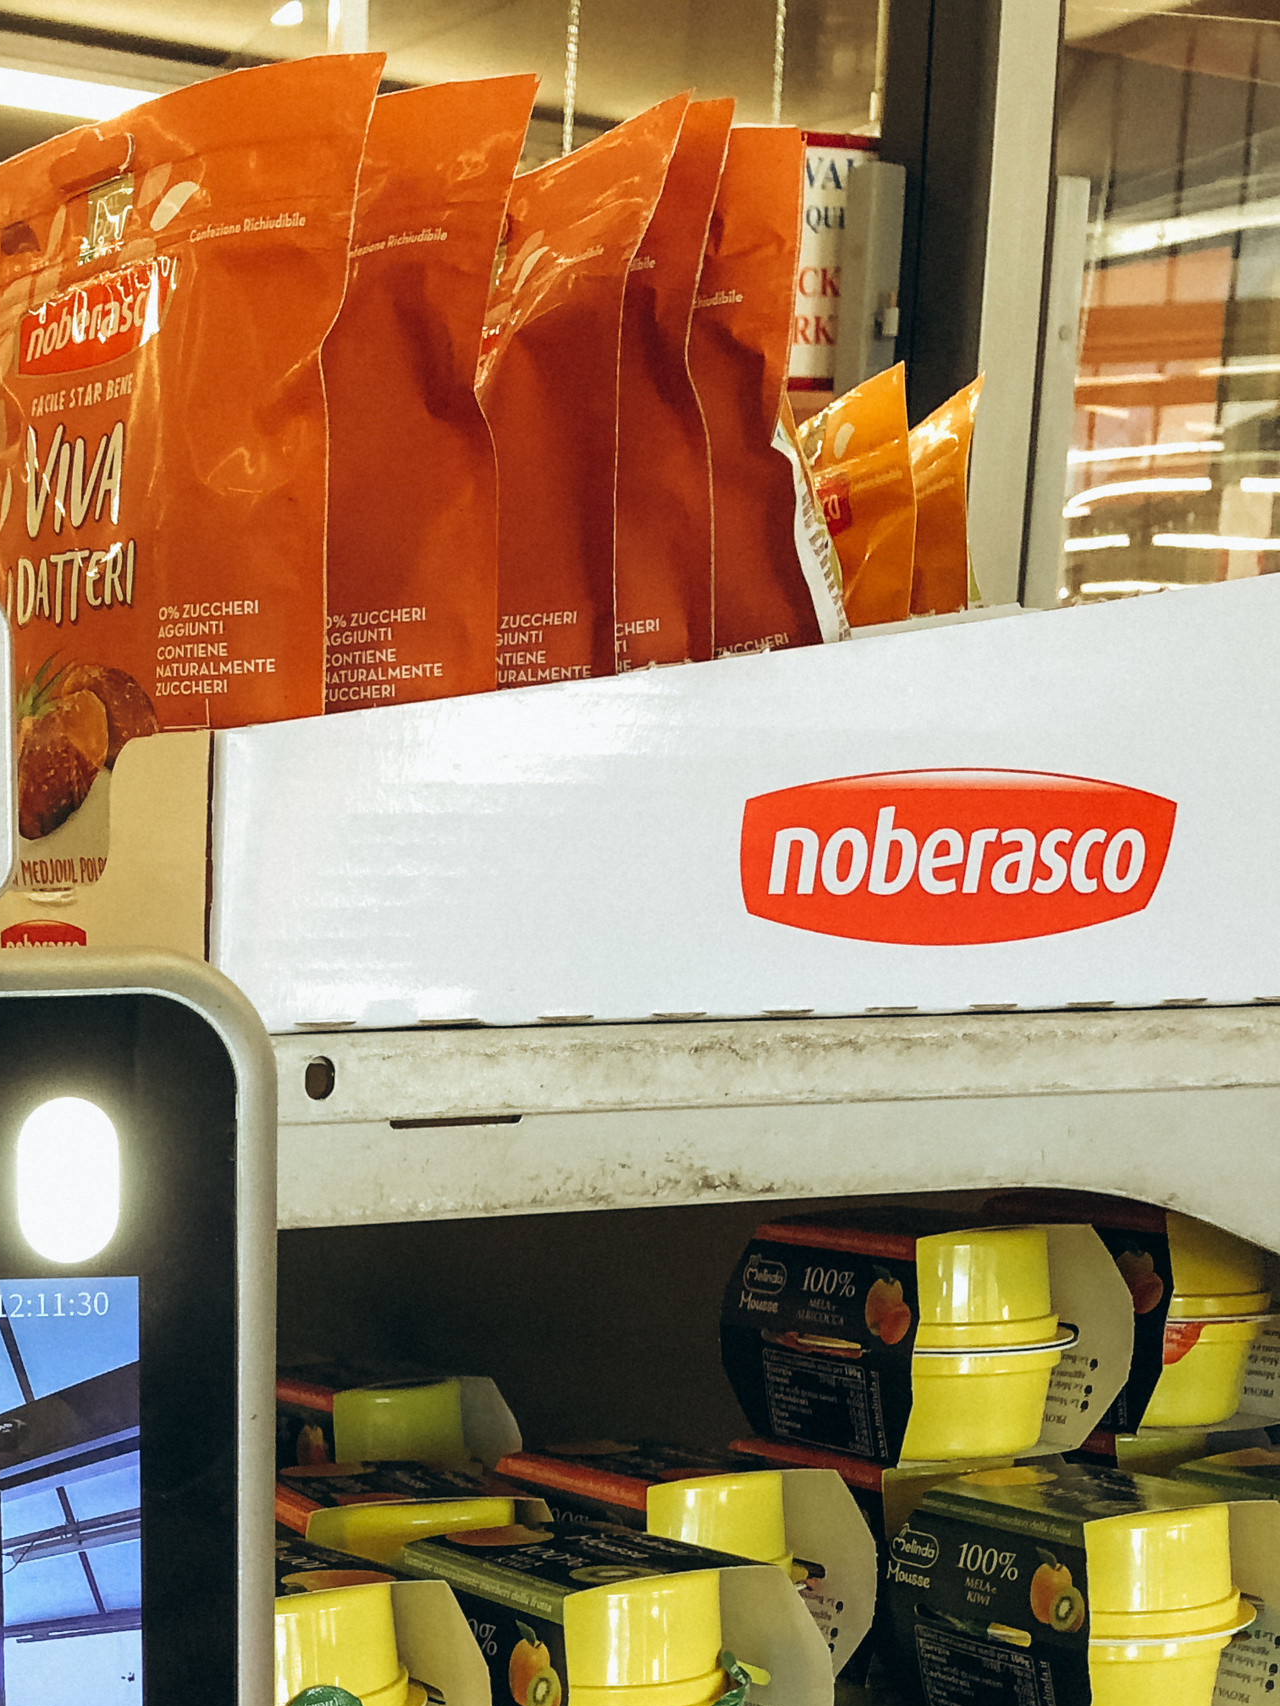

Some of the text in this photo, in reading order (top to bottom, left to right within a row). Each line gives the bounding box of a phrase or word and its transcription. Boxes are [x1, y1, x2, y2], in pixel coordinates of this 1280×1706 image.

[189, 213, 306, 244] Confezione Richiudibile
[387, 229, 448, 250] Richiudibile
[31, 373, 134, 417] FACILE STAR BENE
[26, 421, 124, 538] VIVA
[17, 539, 135, 625] DATTERI
[158, 599, 259, 621] 0% ZUCCHERI
[350, 606, 427, 628] ZUCCHERI
[500, 610, 578, 629] ZUCCHERI
[157, 620, 224, 639] AGGIUNTI
[156, 642, 228, 660] CONTIENE
[155, 658, 276, 679] NATURALMENTE
[155, 679, 228, 697] ZUCCHERI
[768, 806, 1146, 895] noberasco
[21, 857, 77, 885] MEDJOUL
[800, 1266, 856, 1298] 100%
[739, 1290, 779, 1314] Mousse
[892, 1537, 935, 1559] Melinda
[956, 1542, 1018, 1581] 100%
[886, 1560, 930, 1588] Mousse
[965, 1577, 991, 1592] MELA
[966, 1591, 990, 1606] KIWI
